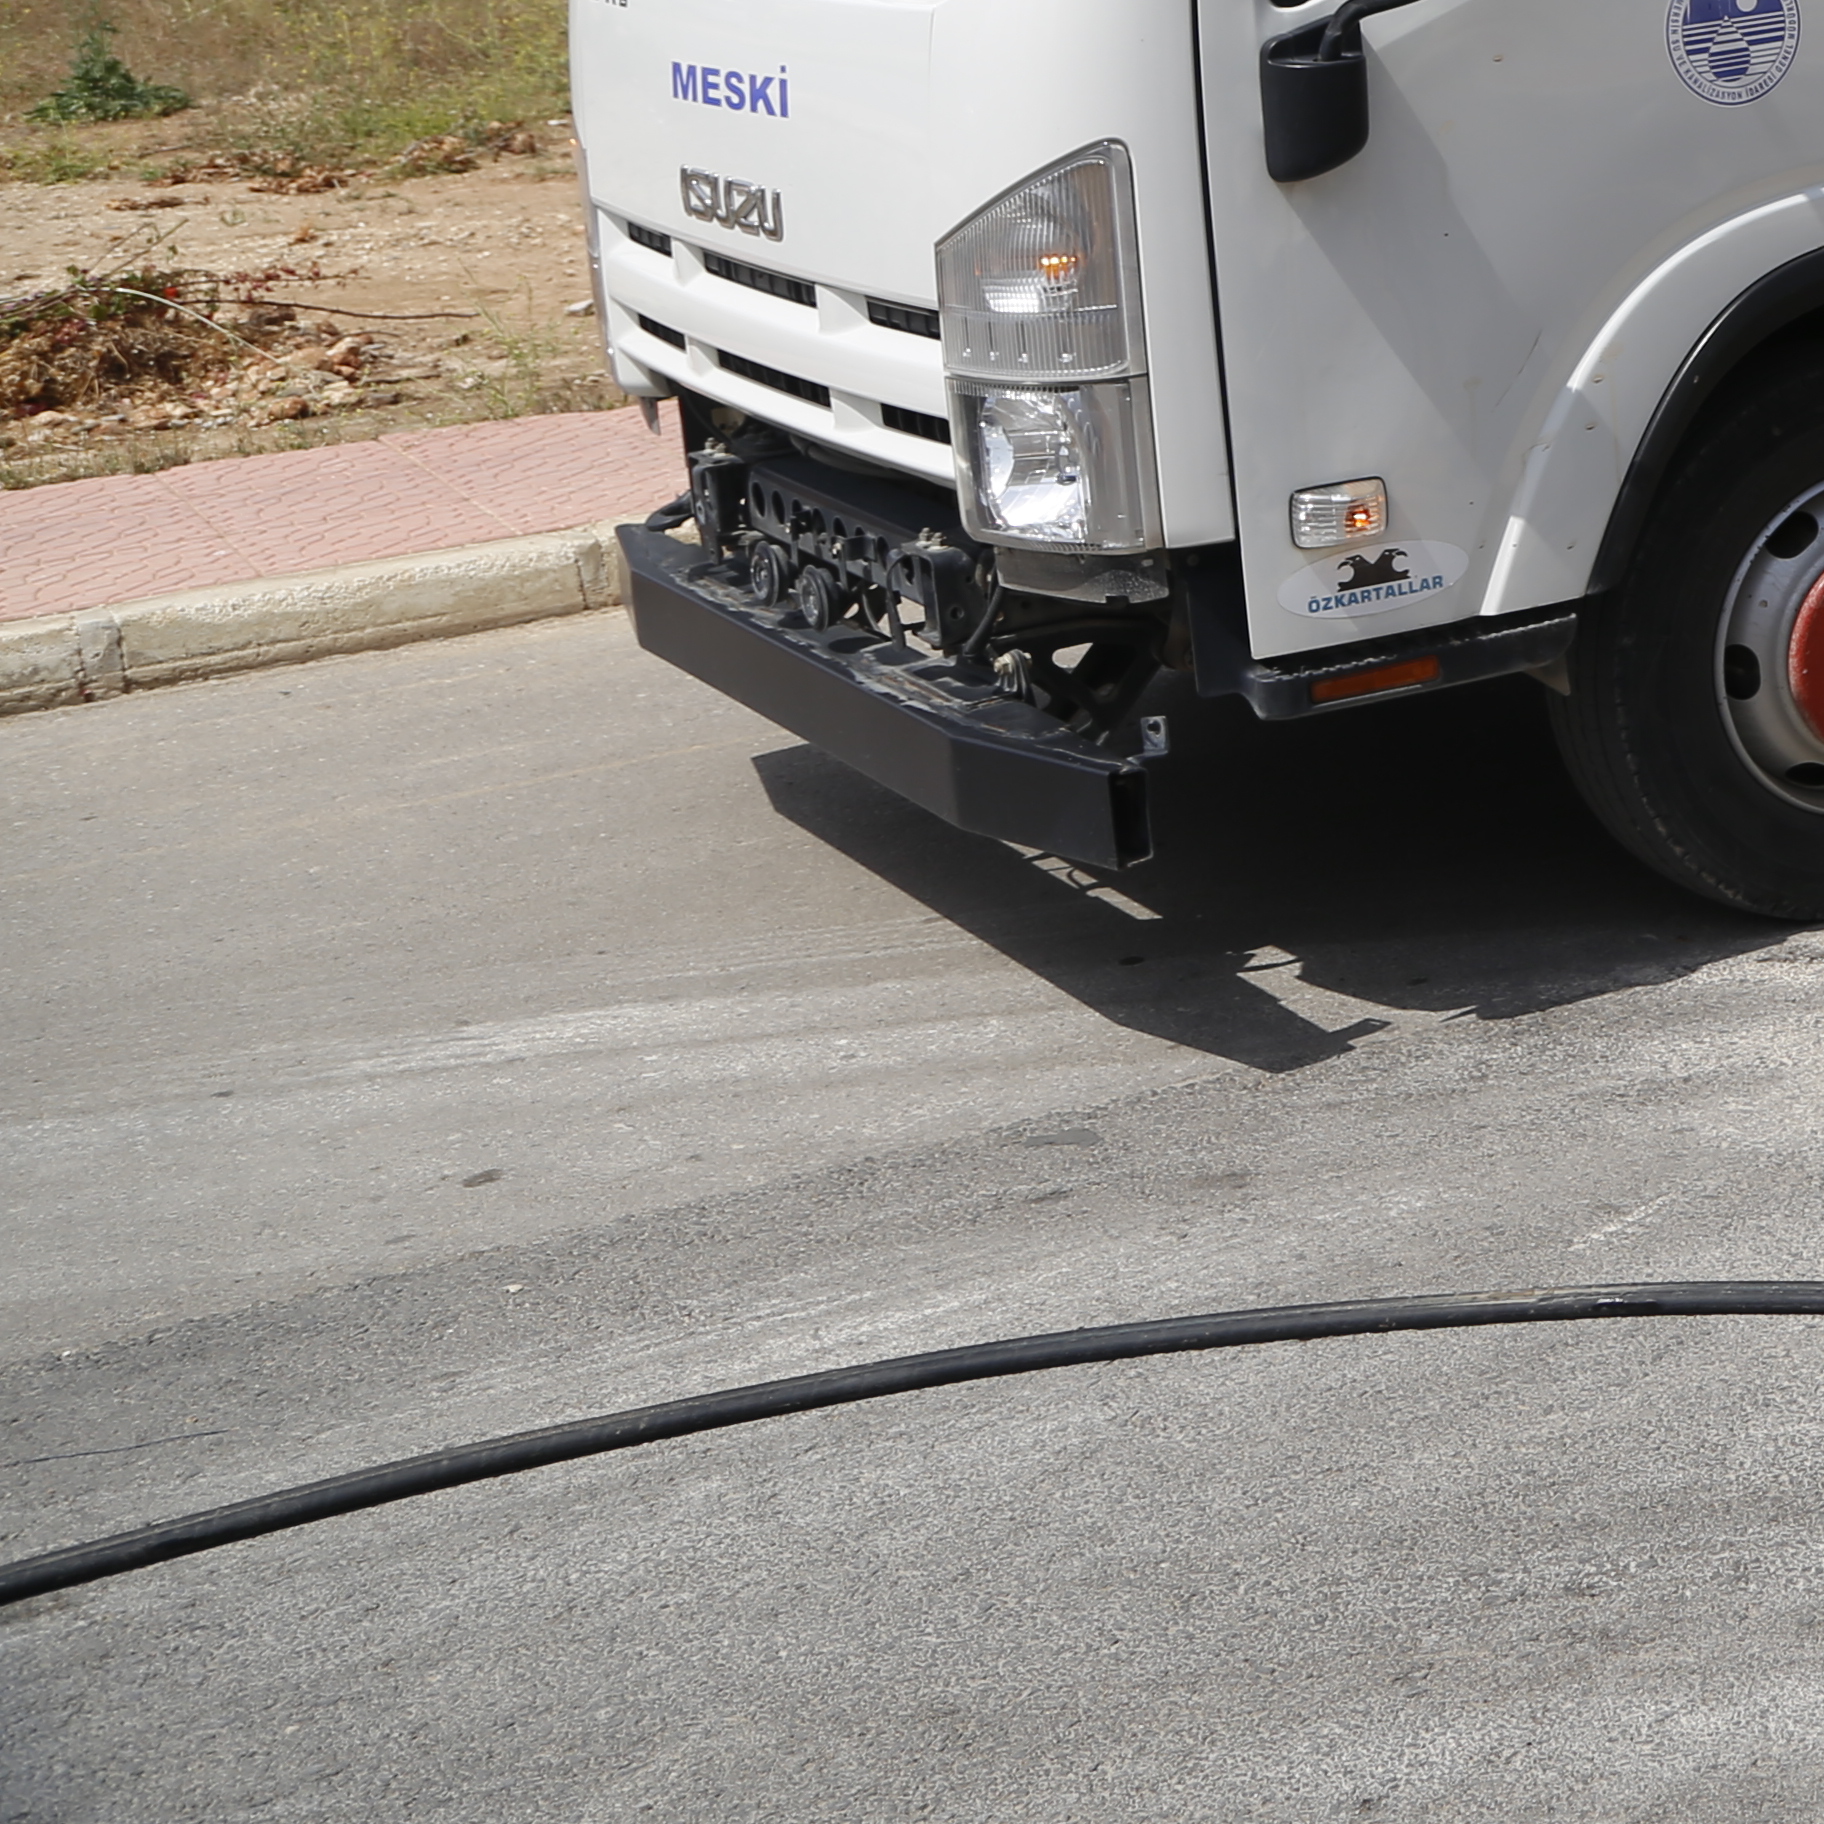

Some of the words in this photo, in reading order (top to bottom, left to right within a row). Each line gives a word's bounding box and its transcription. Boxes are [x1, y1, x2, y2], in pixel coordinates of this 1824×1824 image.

[672, 61, 790, 119] MESKİ
[1675, 53, 1687, 69] VE
[1683, 68, 1743, 101] KANALİZASYON
[1745, 72, 1778, 99] İDARESİ
[1777, 44, 1795, 75] GENEL
[680, 164, 785, 243] ISUZU
[1308, 575, 1444, 614] ÖZKARTALLAR
